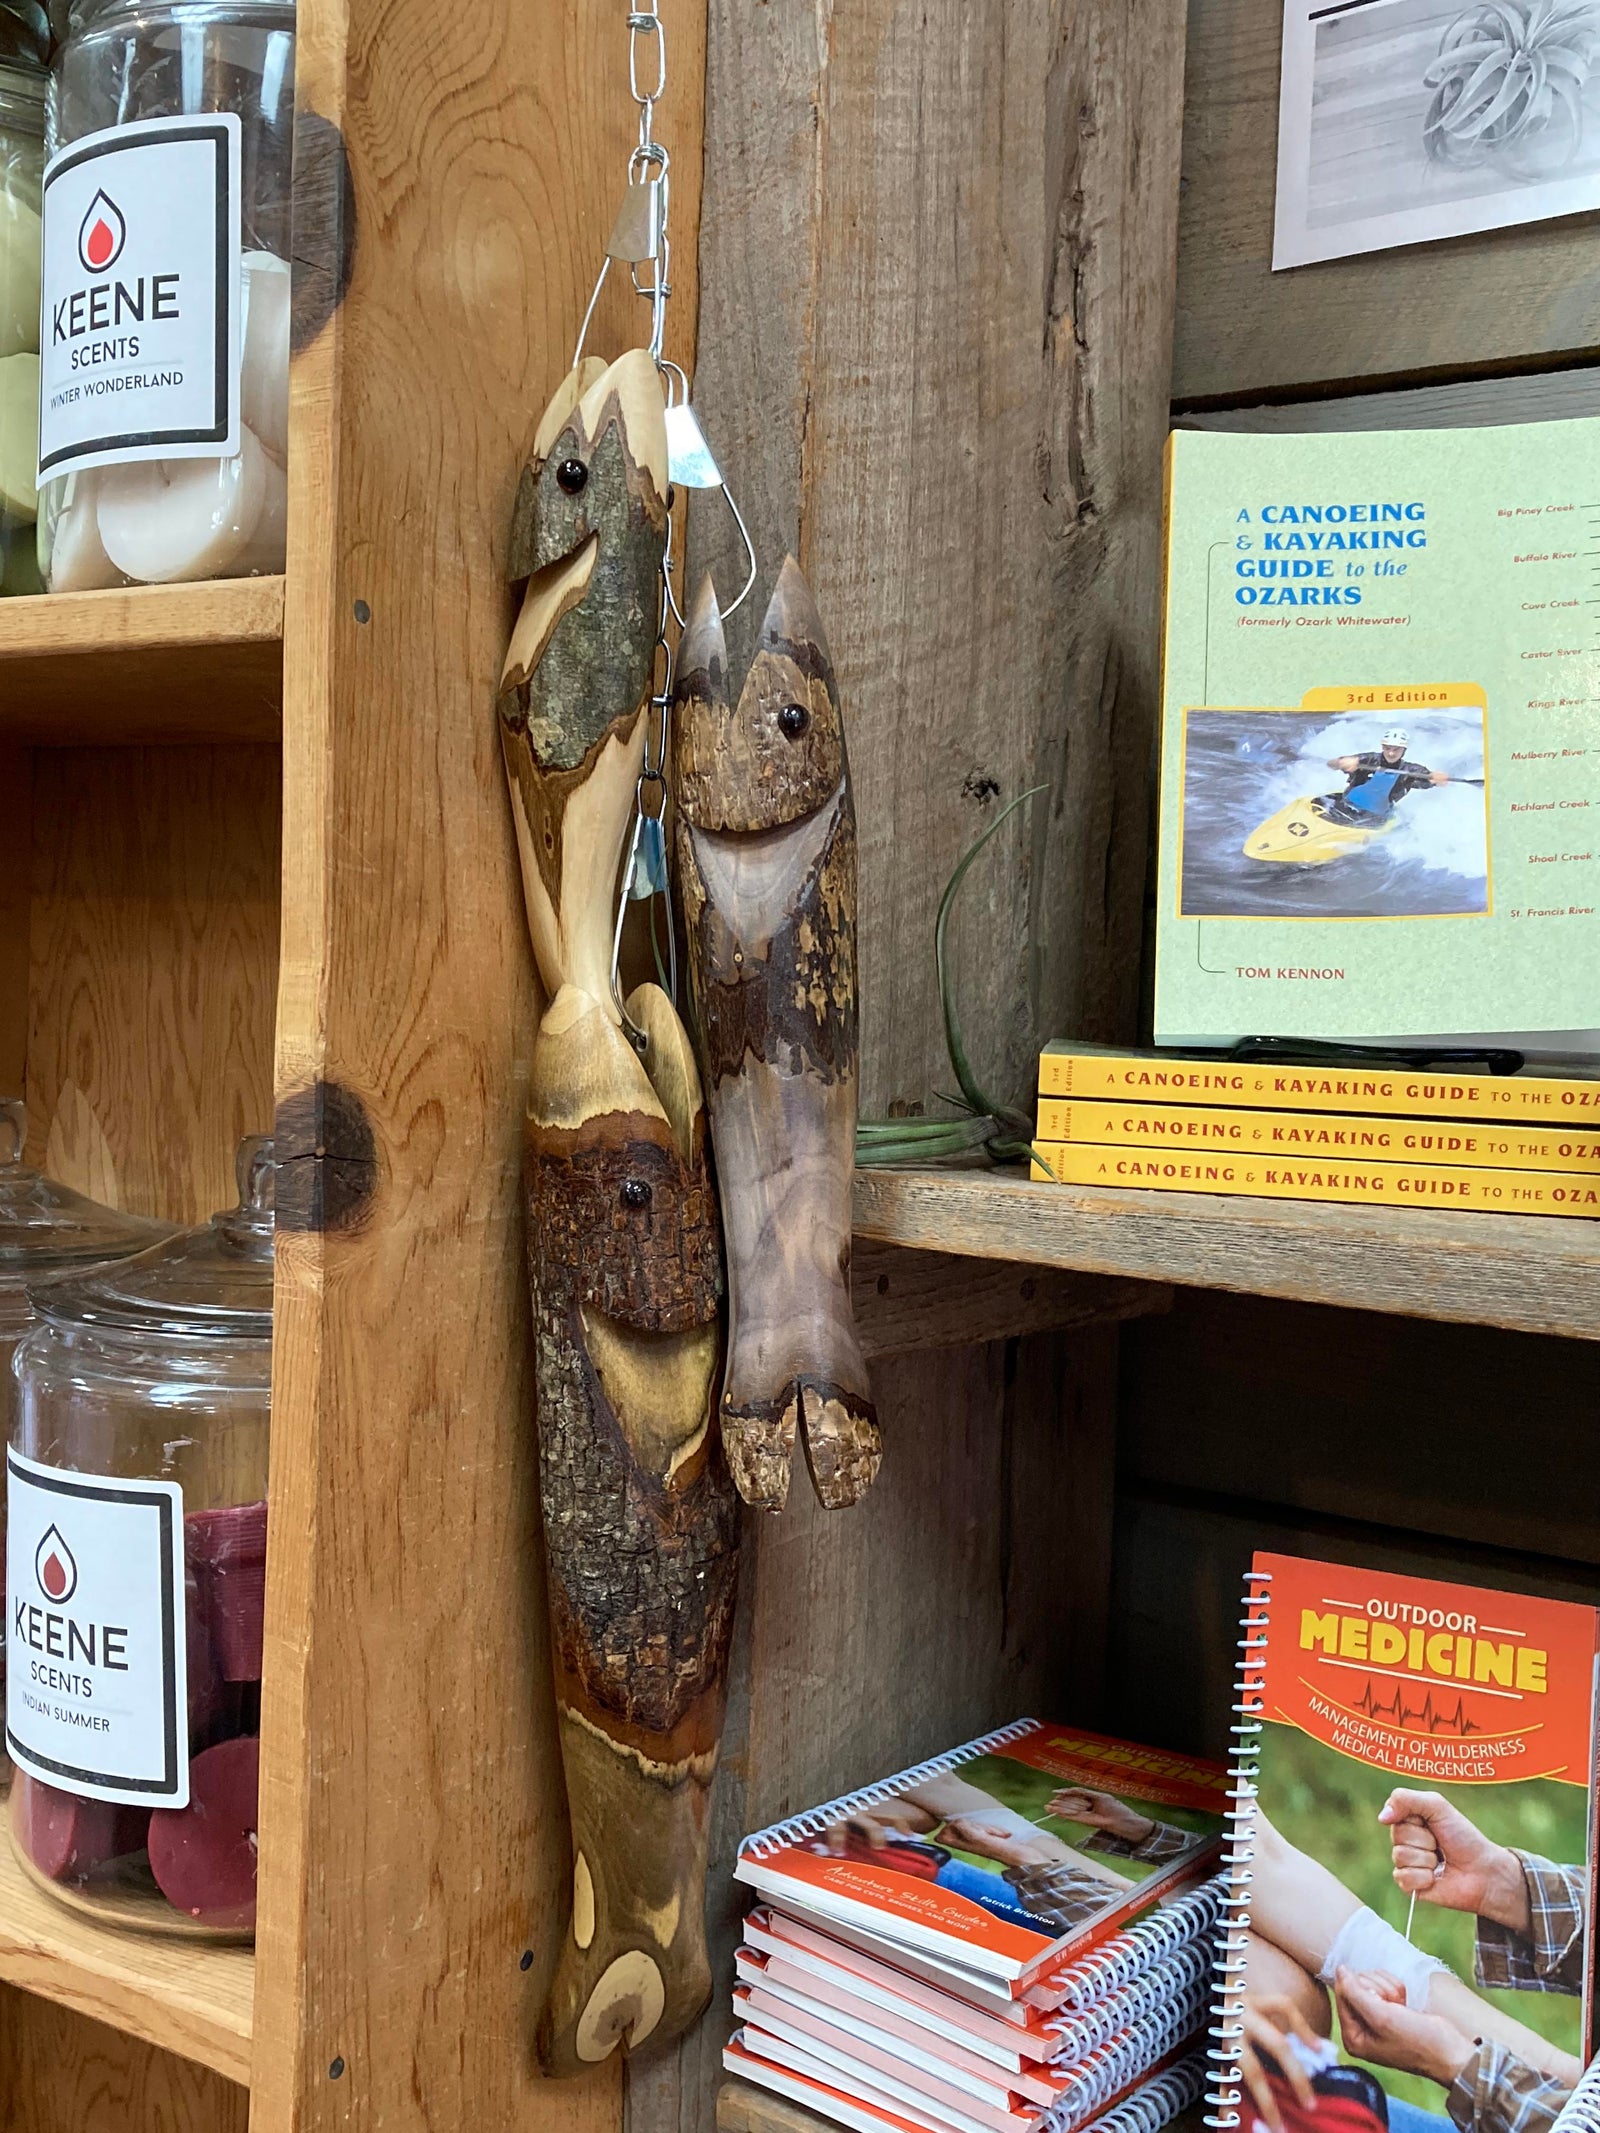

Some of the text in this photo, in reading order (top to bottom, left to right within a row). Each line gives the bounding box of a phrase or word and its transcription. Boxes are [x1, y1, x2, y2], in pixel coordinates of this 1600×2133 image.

[53, 273, 180, 347] KEENE
[71, 336, 140, 370] SCENTS
[50, 371, 184, 411] WINTER WONDERLAND
[1236, 502, 1426, 524] A CANOEING
[1498, 503, 1575, 518] Big Piney Creek
[1236, 529, 1427, 550] & KAYAKING
[1236, 558, 1408, 578] GUIDE to the
[1513, 551, 1578, 563] Buffalo River
[1235, 585, 1362, 606] OZARKS
[1521, 599, 1580, 611] Cave Creek
[1237, 615, 1411, 629] (formerly Ozark Whitewater)
[1520, 648, 1584, 660] Castor River
[1347, 690, 1448, 704] 3rd Edition
[1527, 697, 1586, 709] Kings River
[1511, 748, 1588, 761] Mulberry River
[1511, 799, 1590, 812] Richland Creek
[1528, 852, 1592, 863] Shoal Creek
[1511, 906, 1595, 918] St. Francis River
[1235, 966, 1345, 980] TOM KENNON
[1106, 1073, 1116, 1084] A
[1124, 1071, 1244, 1089] CANOEING
[1254, 1080, 1265, 1091] &
[1274, 1078, 1393, 1097] KAYAKING
[1406, 1084, 1480, 1101] GUIDE
[1491, 1091, 1511, 1103] TO
[1520, 1093, 1552, 1104] THE
[1064, 1106, 1072, 1138] Edition
[1105, 1121, 1114, 1131] A
[1123, 1119, 1242, 1139] CANOEING
[1252, 1129, 1263, 1140] &
[1272, 1127, 1391, 1147] KAYAKING
[1404, 1135, 1478, 1152] GUIDE
[1488, 1143, 1509, 1154] TO
[1518, 1144, 1549, 1156] THE
[1098, 1163, 1107, 1173] A
[1116, 1161, 1235, 1181] CANOEING
[1246, 1172, 1256, 1183] &
[1265, 1170, 1384, 1190] KAYAKING
[1397, 1178, 1471, 1196] GUIDE
[1482, 1187, 1502, 1198] TO
[1512, 1188, 1543, 1200] THE
[1366, 1598, 1478, 1635] OUTDOOR
[15, 1595, 129, 1671] KEENE
[1300, 1608, 1548, 1694] MEDICINE
[31, 1660, 93, 1698] SCENTS
[22, 1690, 110, 1733] INDIAN SUMMER
[1308, 1696, 1526, 1760] MANAGEMENT OF WILDERNESS
[1332, 1729, 1496, 1777] MEDICAL EMERGENCIES
[824, 1875, 845, 1885] CARE
[845, 1883, 862, 1891] FOR
[925, 1912, 945, 1921] AND
[946, 1919, 971, 1931] MORE
[826, 1866, 988, 1927] Adventure Skills Guides
[979, 1895, 1056, 1926] Patrick Brighton
